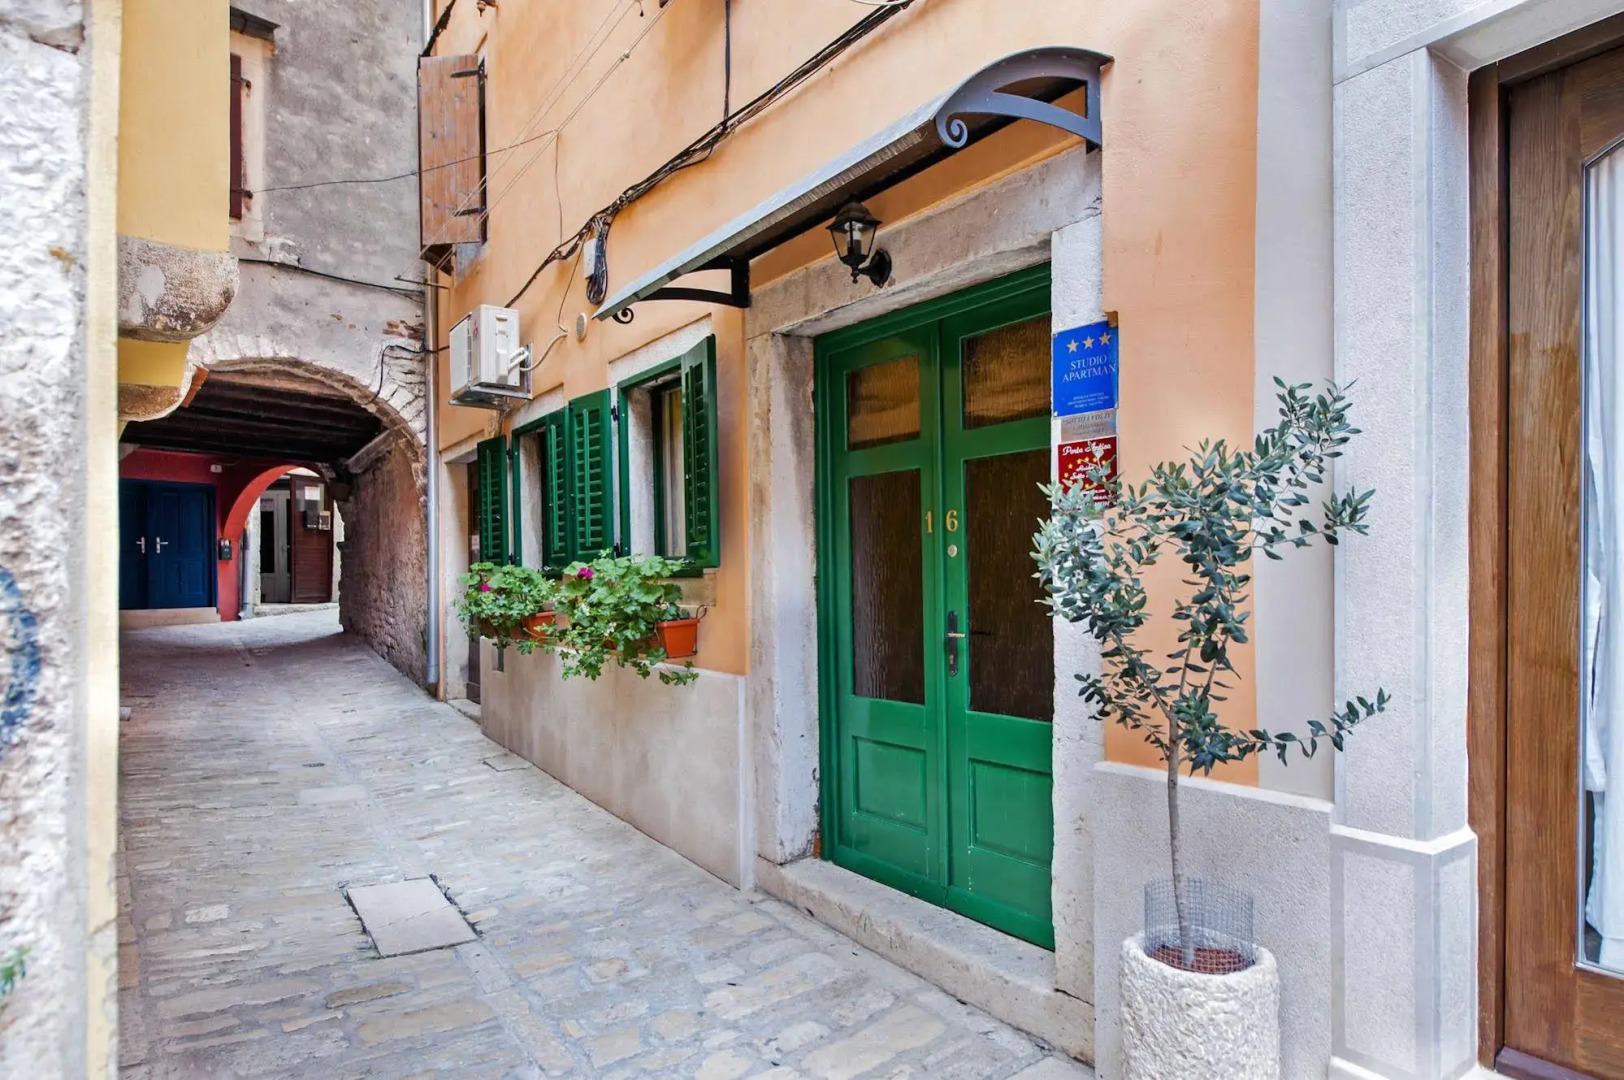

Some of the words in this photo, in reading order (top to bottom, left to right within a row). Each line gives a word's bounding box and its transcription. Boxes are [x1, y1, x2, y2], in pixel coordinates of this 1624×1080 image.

[1070, 354, 1107, 370] STUDIO
[1062, 363, 1116, 382] APARTMAN
[1062, 445, 1083, 456] Porta
